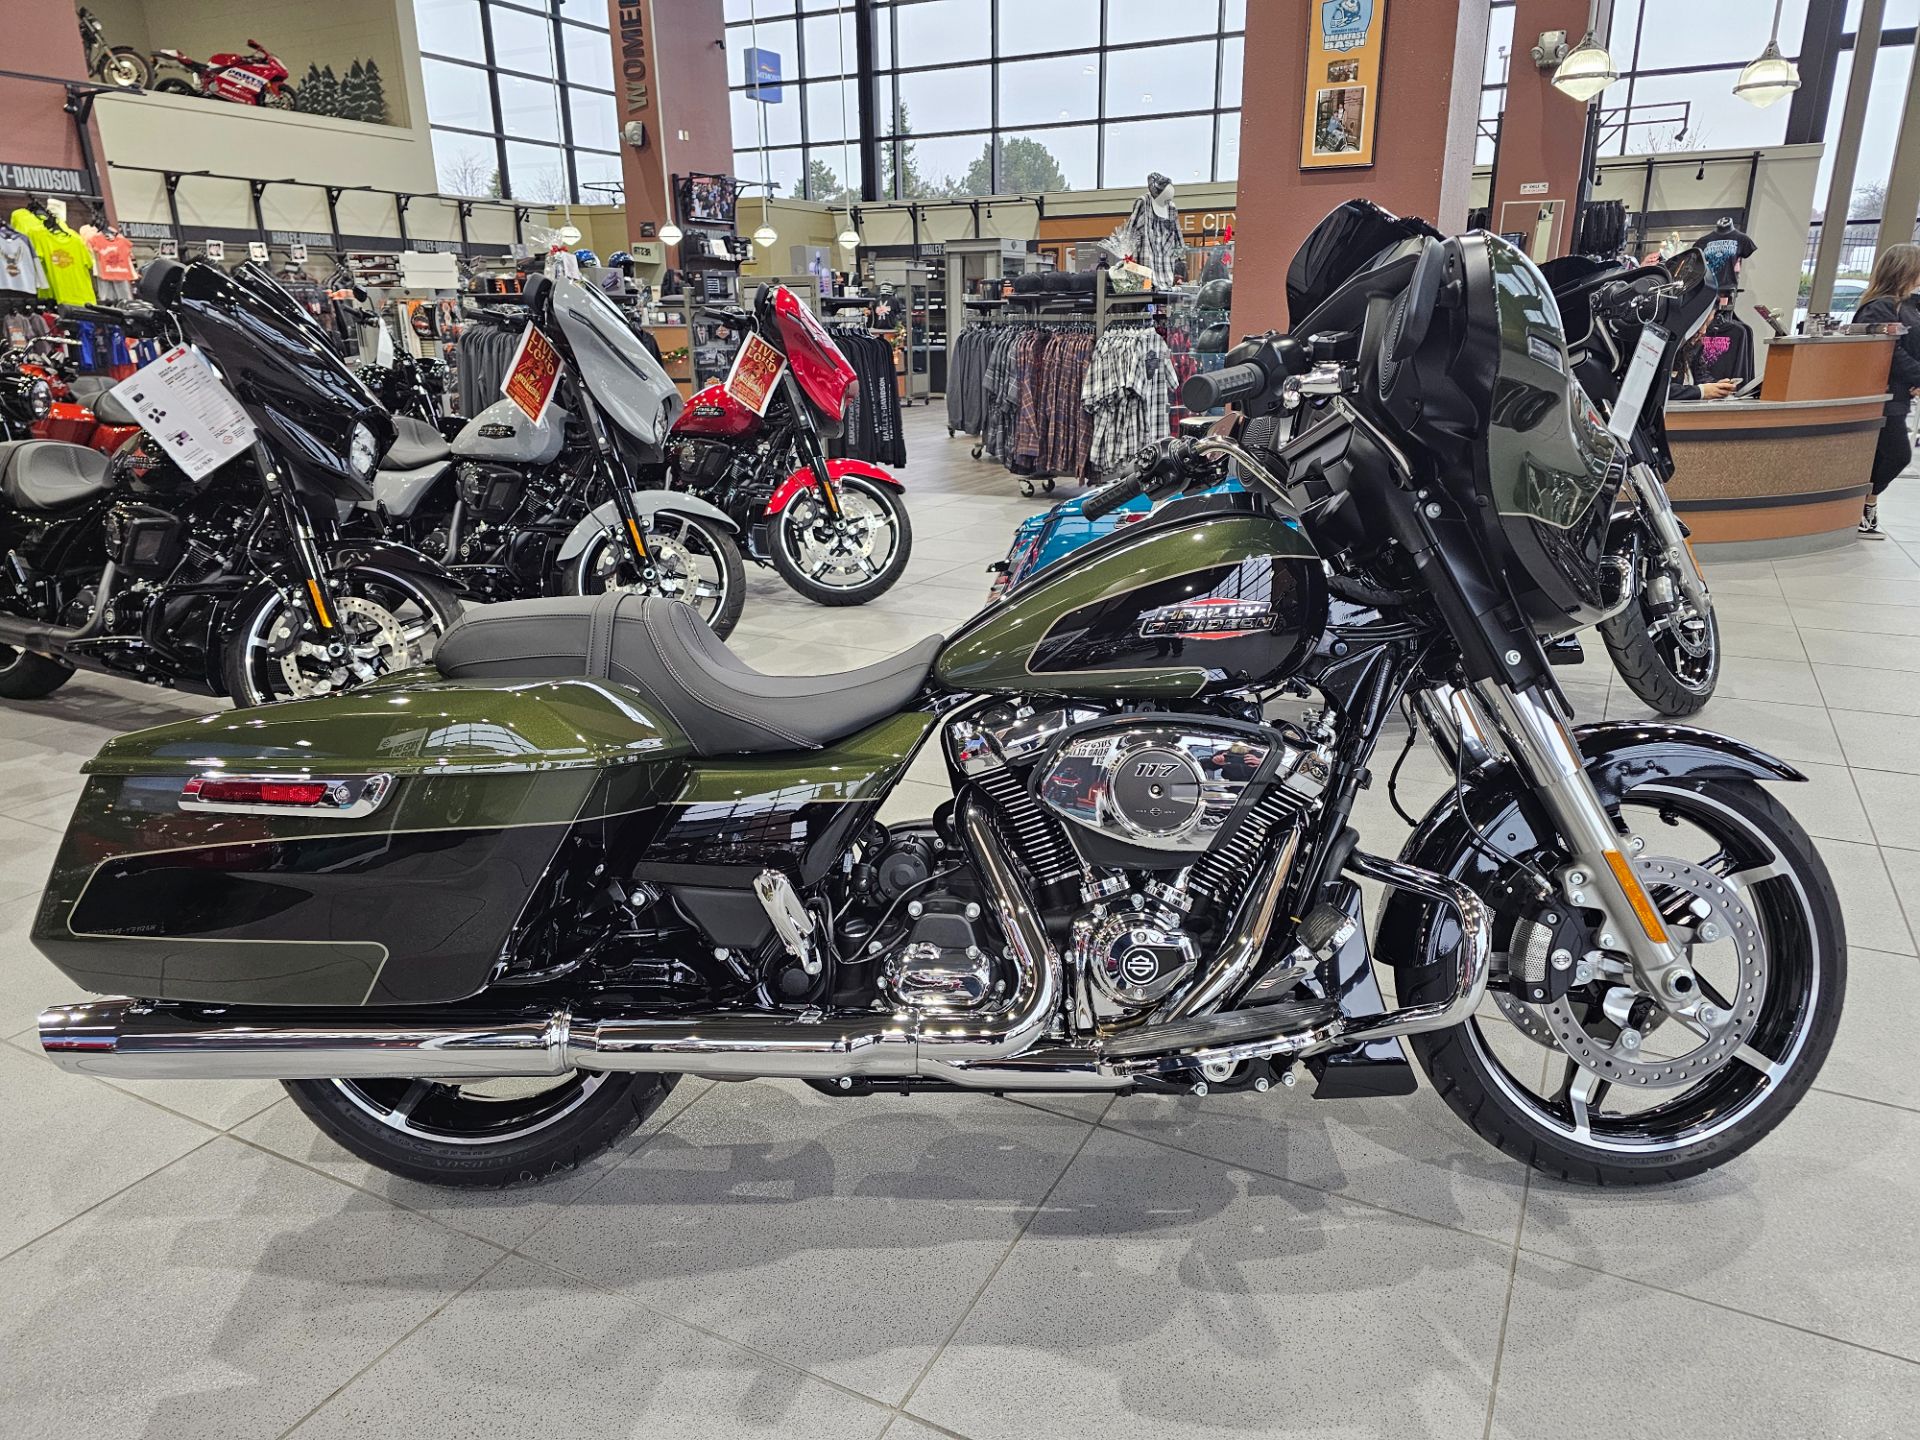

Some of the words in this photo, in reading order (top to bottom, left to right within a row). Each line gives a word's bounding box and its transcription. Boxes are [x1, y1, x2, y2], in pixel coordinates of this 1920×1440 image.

[1323, 38, 1365, 50] BASH
[0, 164, 82, 192] Y-DAVIDSON
[529, 329, 556, 362] LIVE
[749, 338, 777, 363] LIVE
[879, 376, 891, 441] HARLEY-DAVIDSON
[1146, 617, 1273, 634] DAVIDSON
[1134, 762, 1181, 777] 117
